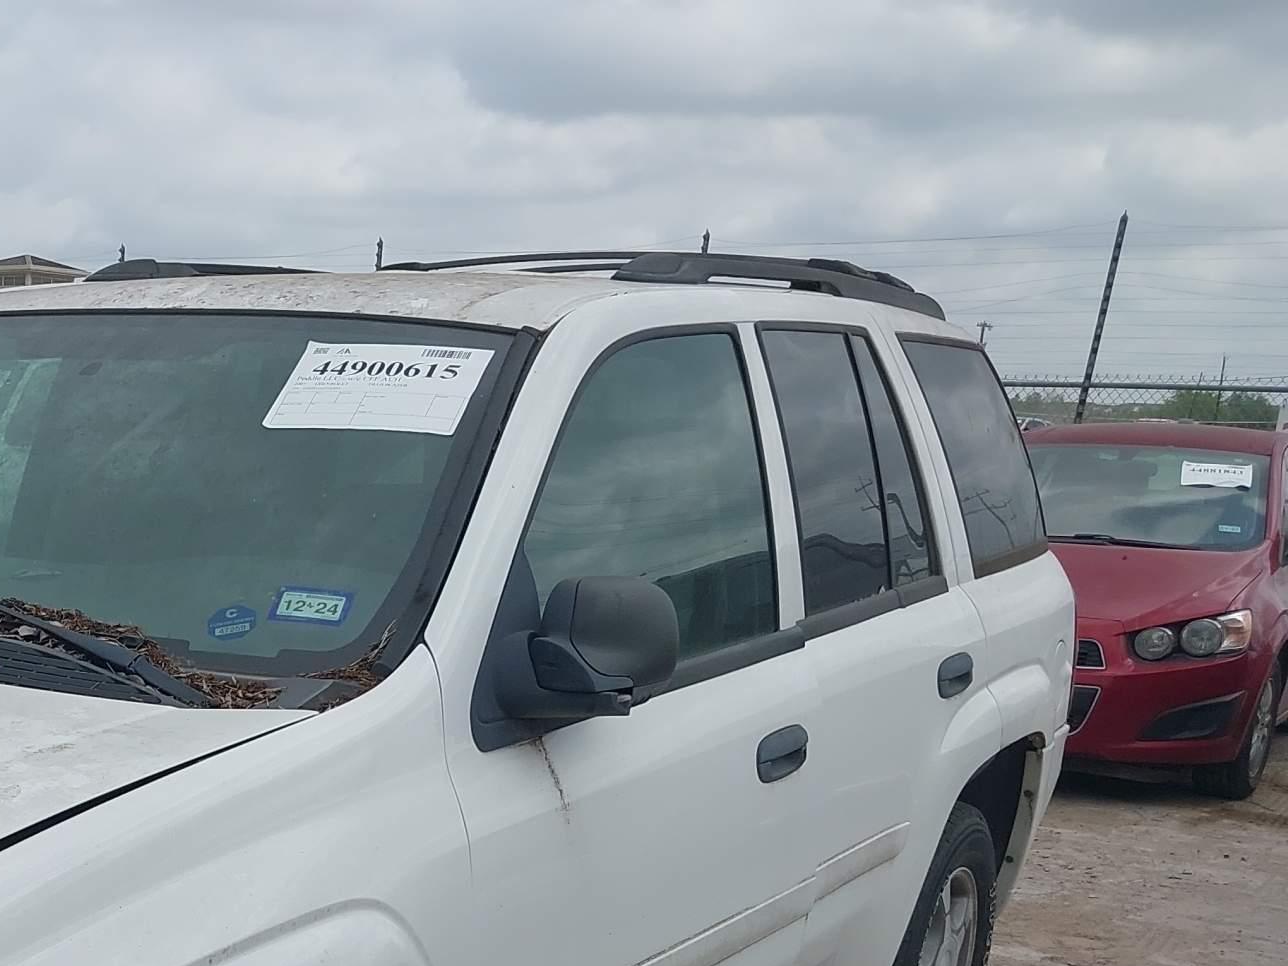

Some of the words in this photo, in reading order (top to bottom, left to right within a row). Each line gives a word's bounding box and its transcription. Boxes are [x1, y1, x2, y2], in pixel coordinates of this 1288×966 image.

[312, 359, 462, 381] 44900615
[283, 599, 306, 613] 12
[313, 601, 339, 615] 24
